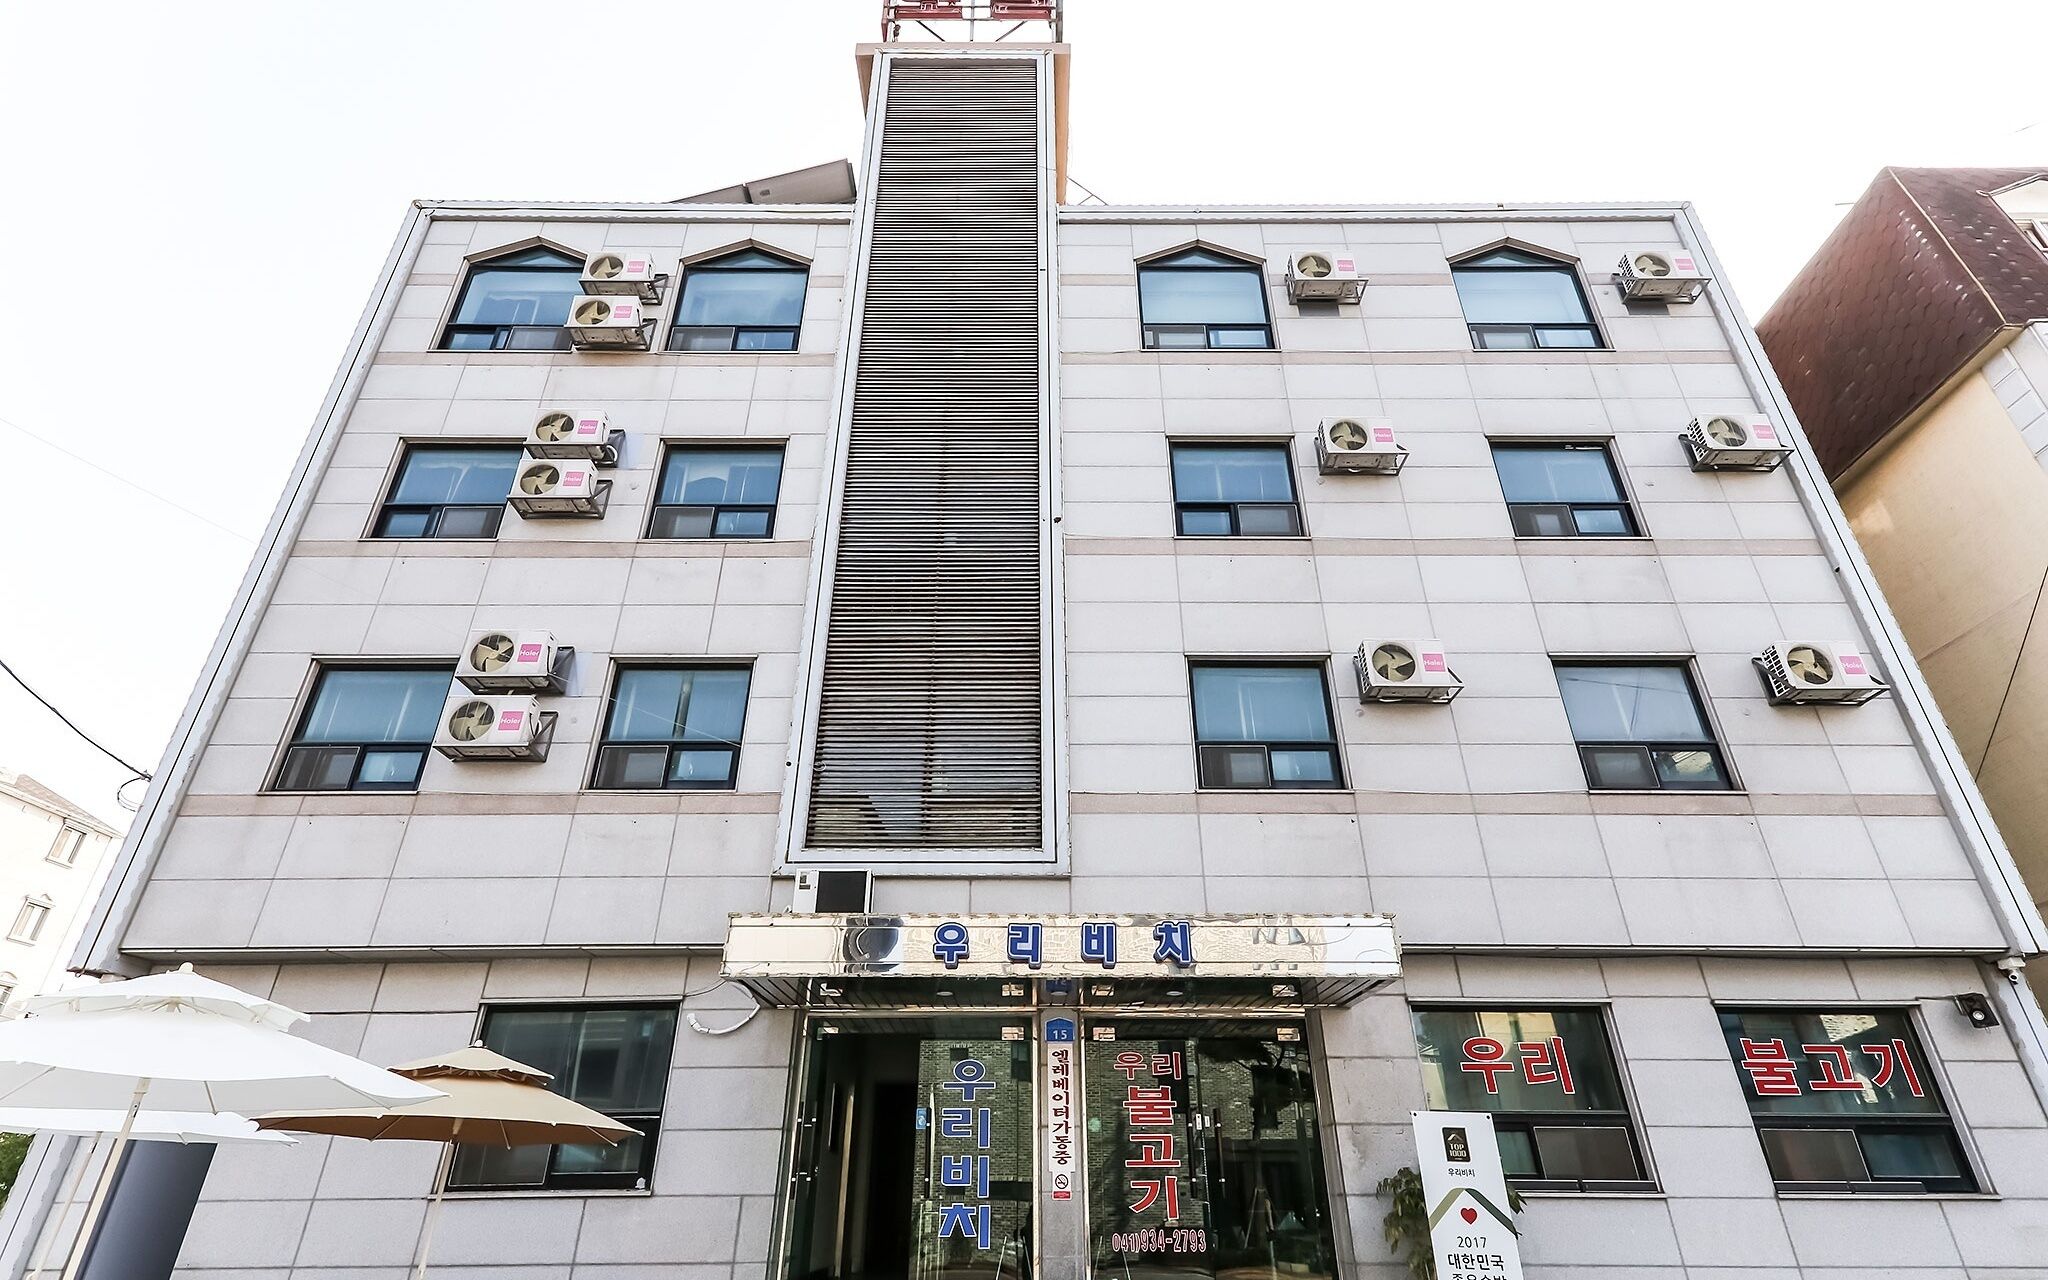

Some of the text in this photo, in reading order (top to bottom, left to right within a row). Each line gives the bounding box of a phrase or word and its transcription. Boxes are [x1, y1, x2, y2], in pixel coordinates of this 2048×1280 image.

[1843, 661, 1863, 669] Haier
[933, 921, 1194, 969] 우리비치
[1053, 1030, 1068, 1040] 15
[1113, 1051, 1182, 1080] 우리
[1459, 1035, 1576, 1095] 우리
[1740, 1037, 1926, 1098] 불고기
[937, 1059, 996, 1250] 우리비치
[1122, 1085, 1182, 1221] 불고기
[1448, 1168, 1476, 1178] 우리비치
[1111, 1228, 1207, 1253] 041)934-2793
[1456, 1236, 1487, 1249] 2017
[1447, 1253, 1505, 1272] 대한민국
